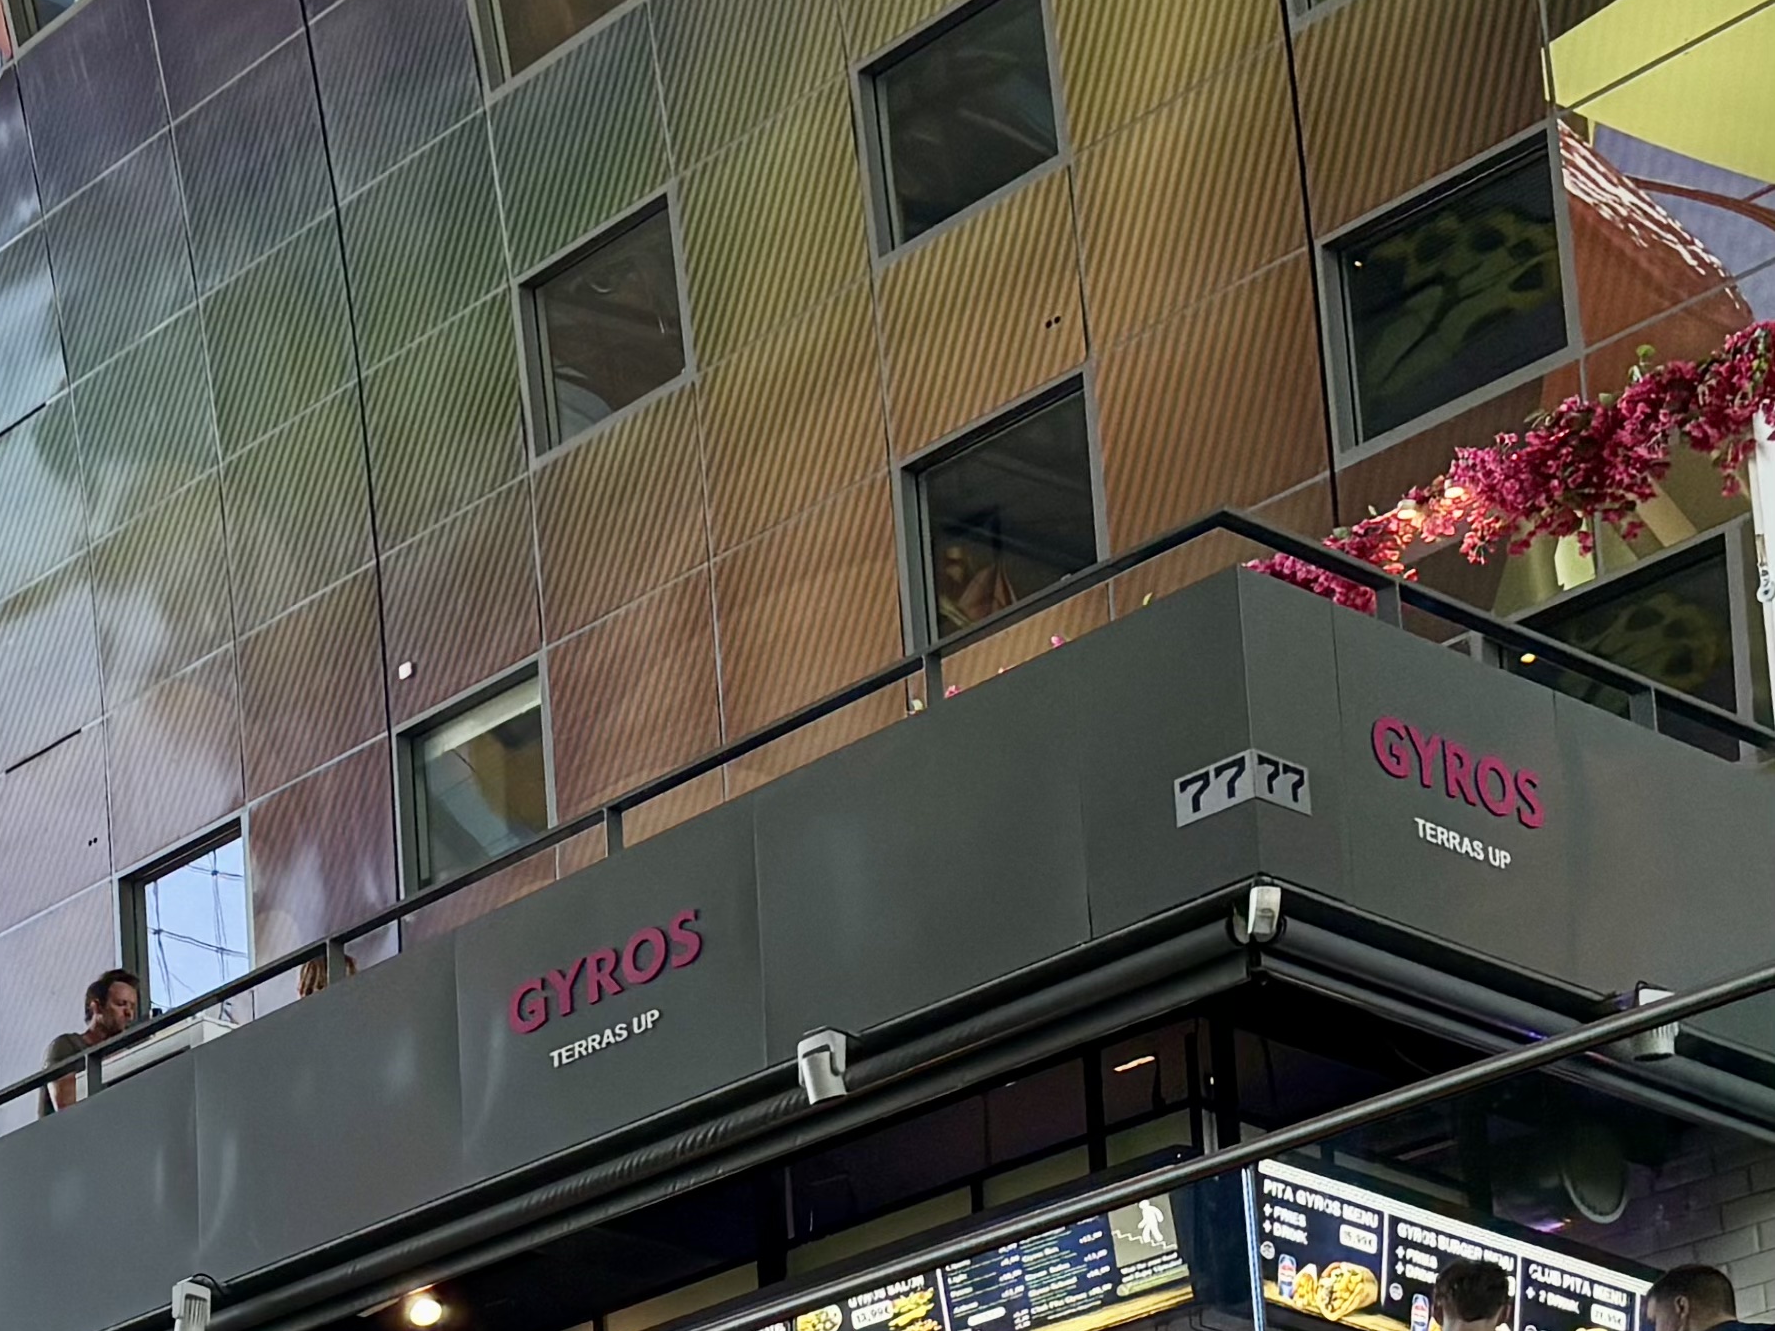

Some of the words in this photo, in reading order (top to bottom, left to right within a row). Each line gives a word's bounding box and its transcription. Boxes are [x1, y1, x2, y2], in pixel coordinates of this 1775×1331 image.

[1179, 756, 1246, 814] 77
[1257, 754, 1305, 804] 77
[1373, 716, 1546, 829] GYROS
[1414, 817, 1484, 860] TERRAS
[1487, 845, 1511, 870] UP
[508, 909, 703, 1034] GYROS
[550, 1022, 629, 1068] TERRAS
[632, 1008, 661, 1036] UP
[1263, 1179, 1295, 1203] PITA
[1295, 1189, 1341, 1218] GYROS
[1342, 1203, 1379, 1229] MENU
[1396, 1222, 1438, 1249] GYROS
[1529, 1263, 1562, 1288] CLUB
[1562, 1272, 1592, 1298] PITA
